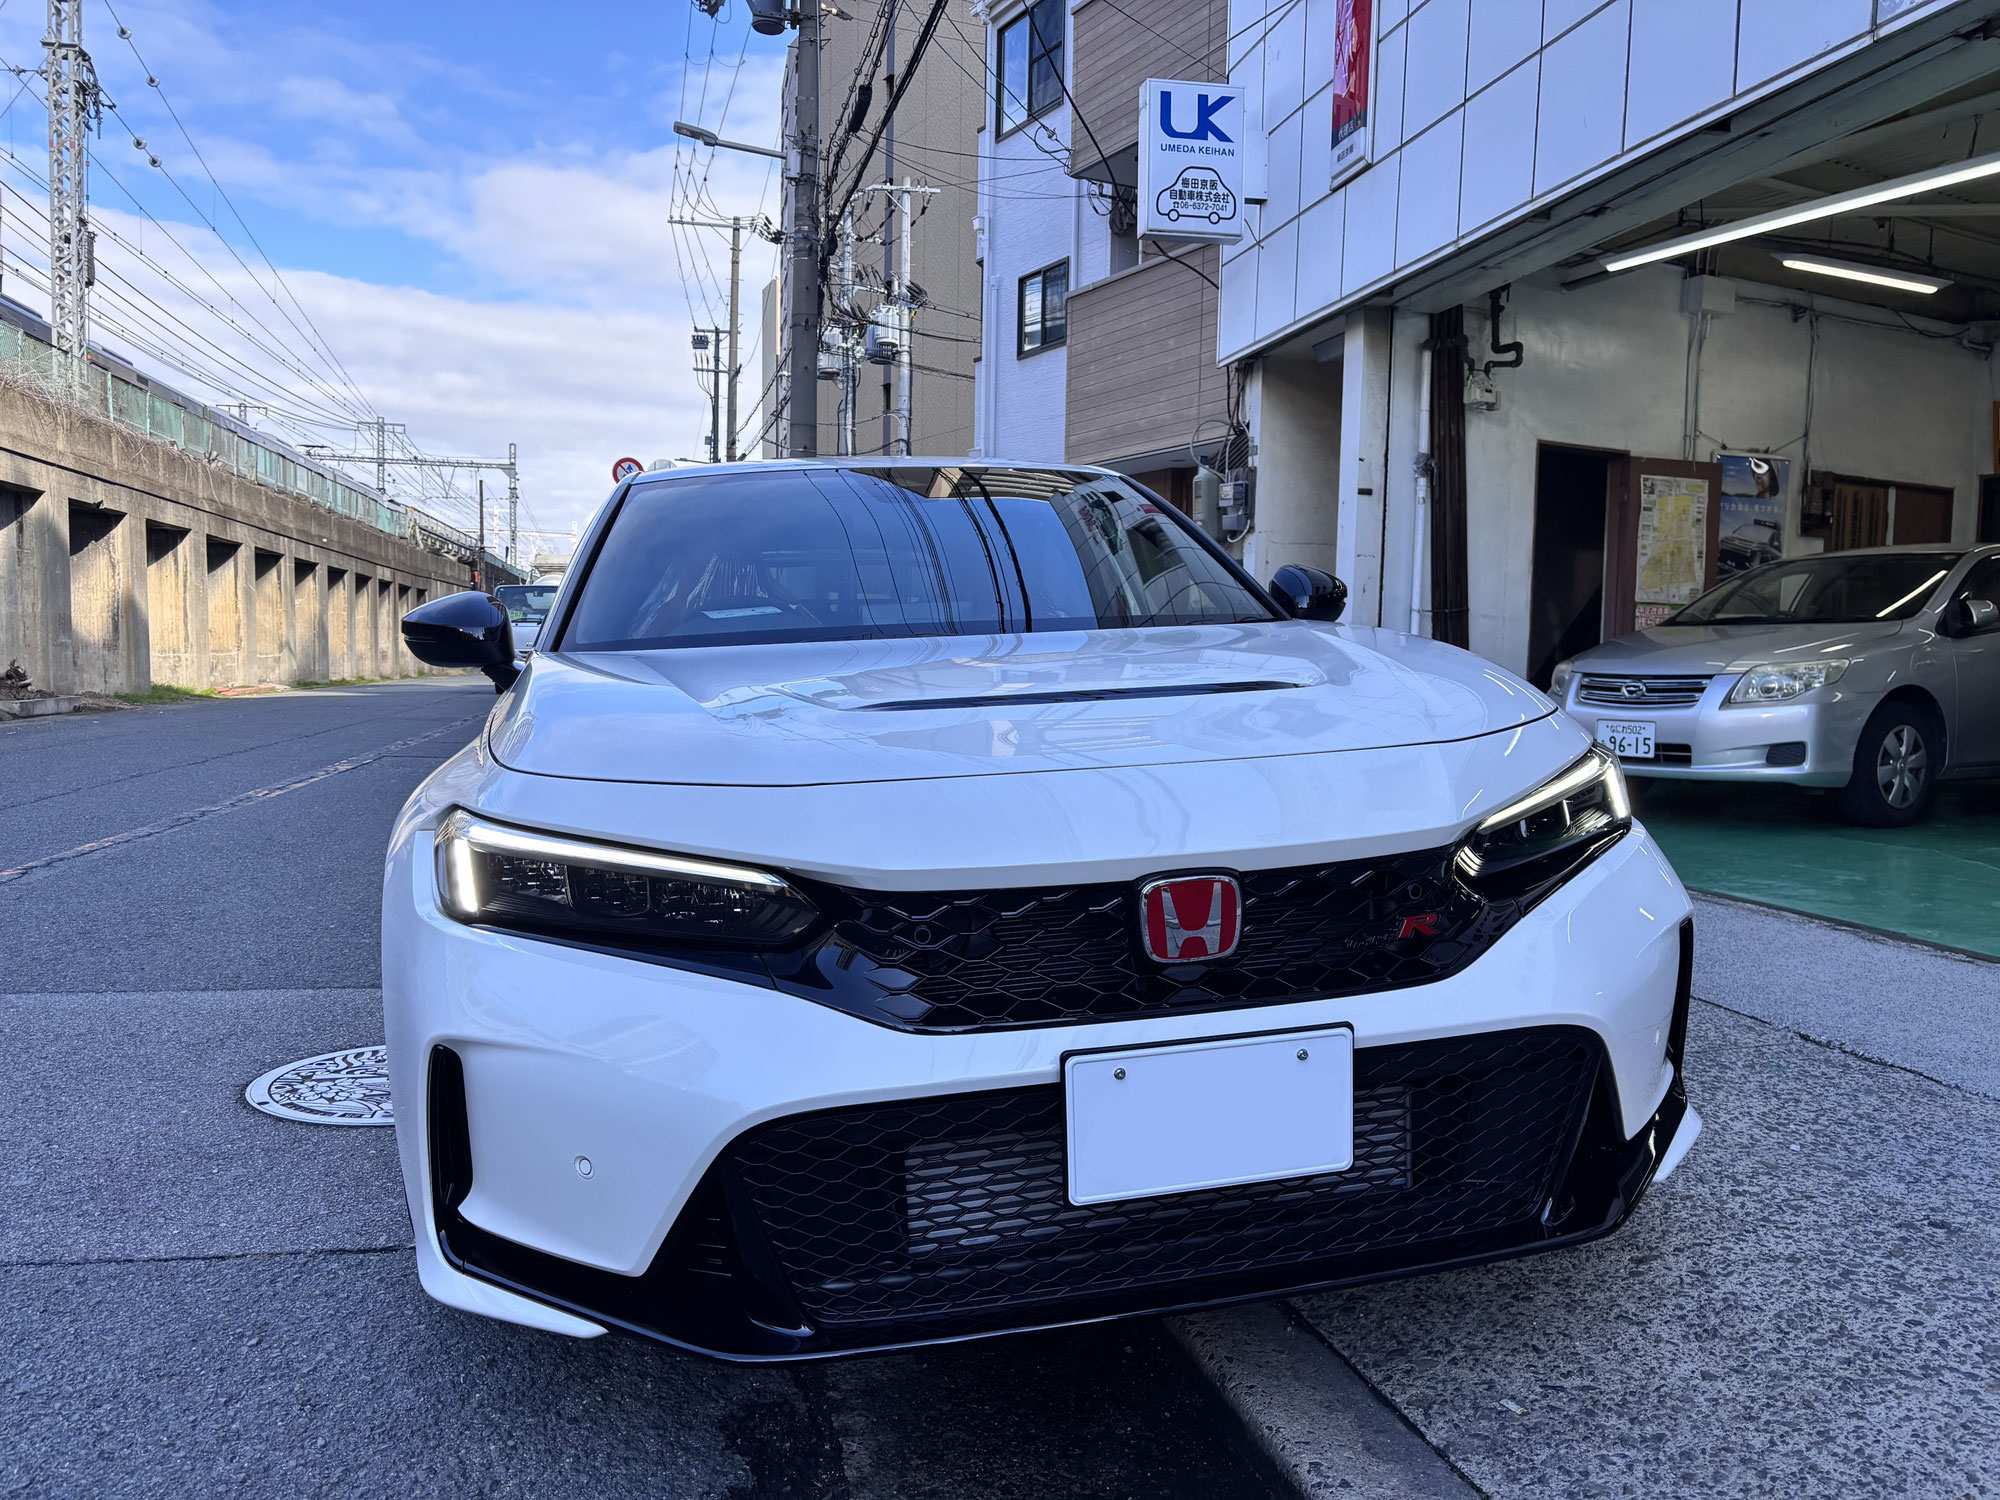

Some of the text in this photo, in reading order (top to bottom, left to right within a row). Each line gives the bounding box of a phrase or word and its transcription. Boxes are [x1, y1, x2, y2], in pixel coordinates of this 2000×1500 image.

[1160, 90, 1236, 143] UK
[1161, 143, 1235, 157] UMEDA KEIHAN
[1181, 177, 1219, 191] 梅田京阪
[1169, 189, 1230, 204] 自動車株式会社
[1180, 201, 1228, 212] 06-6372-7041
[1609, 735, 1651, 755] 96-15
[1399, 912, 1438, 938] R
